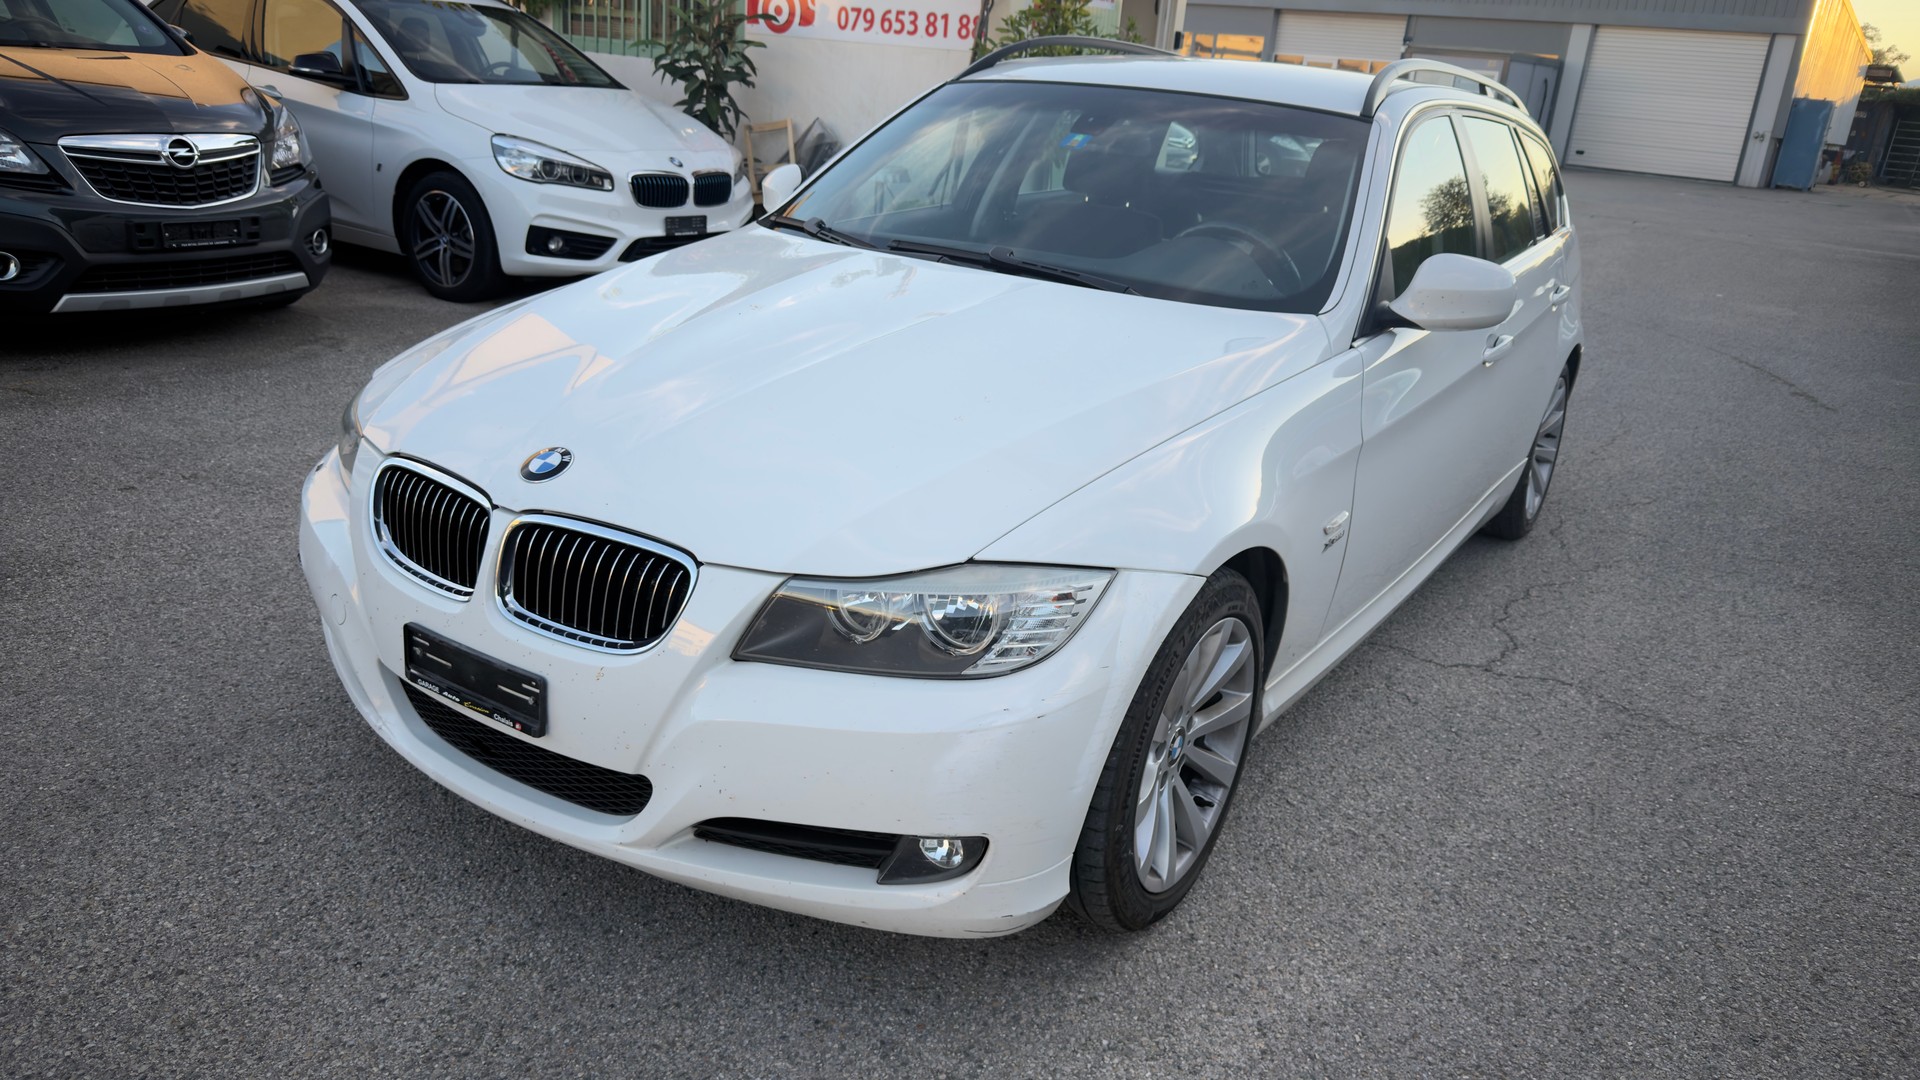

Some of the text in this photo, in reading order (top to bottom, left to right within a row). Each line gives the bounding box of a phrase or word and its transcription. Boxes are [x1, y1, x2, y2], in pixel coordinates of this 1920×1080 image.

[837, 6, 875, 32] 079
[880, 9, 919, 36] 653
[925, 12, 949, 38] 81
[442, 691, 460, 702] Auto
